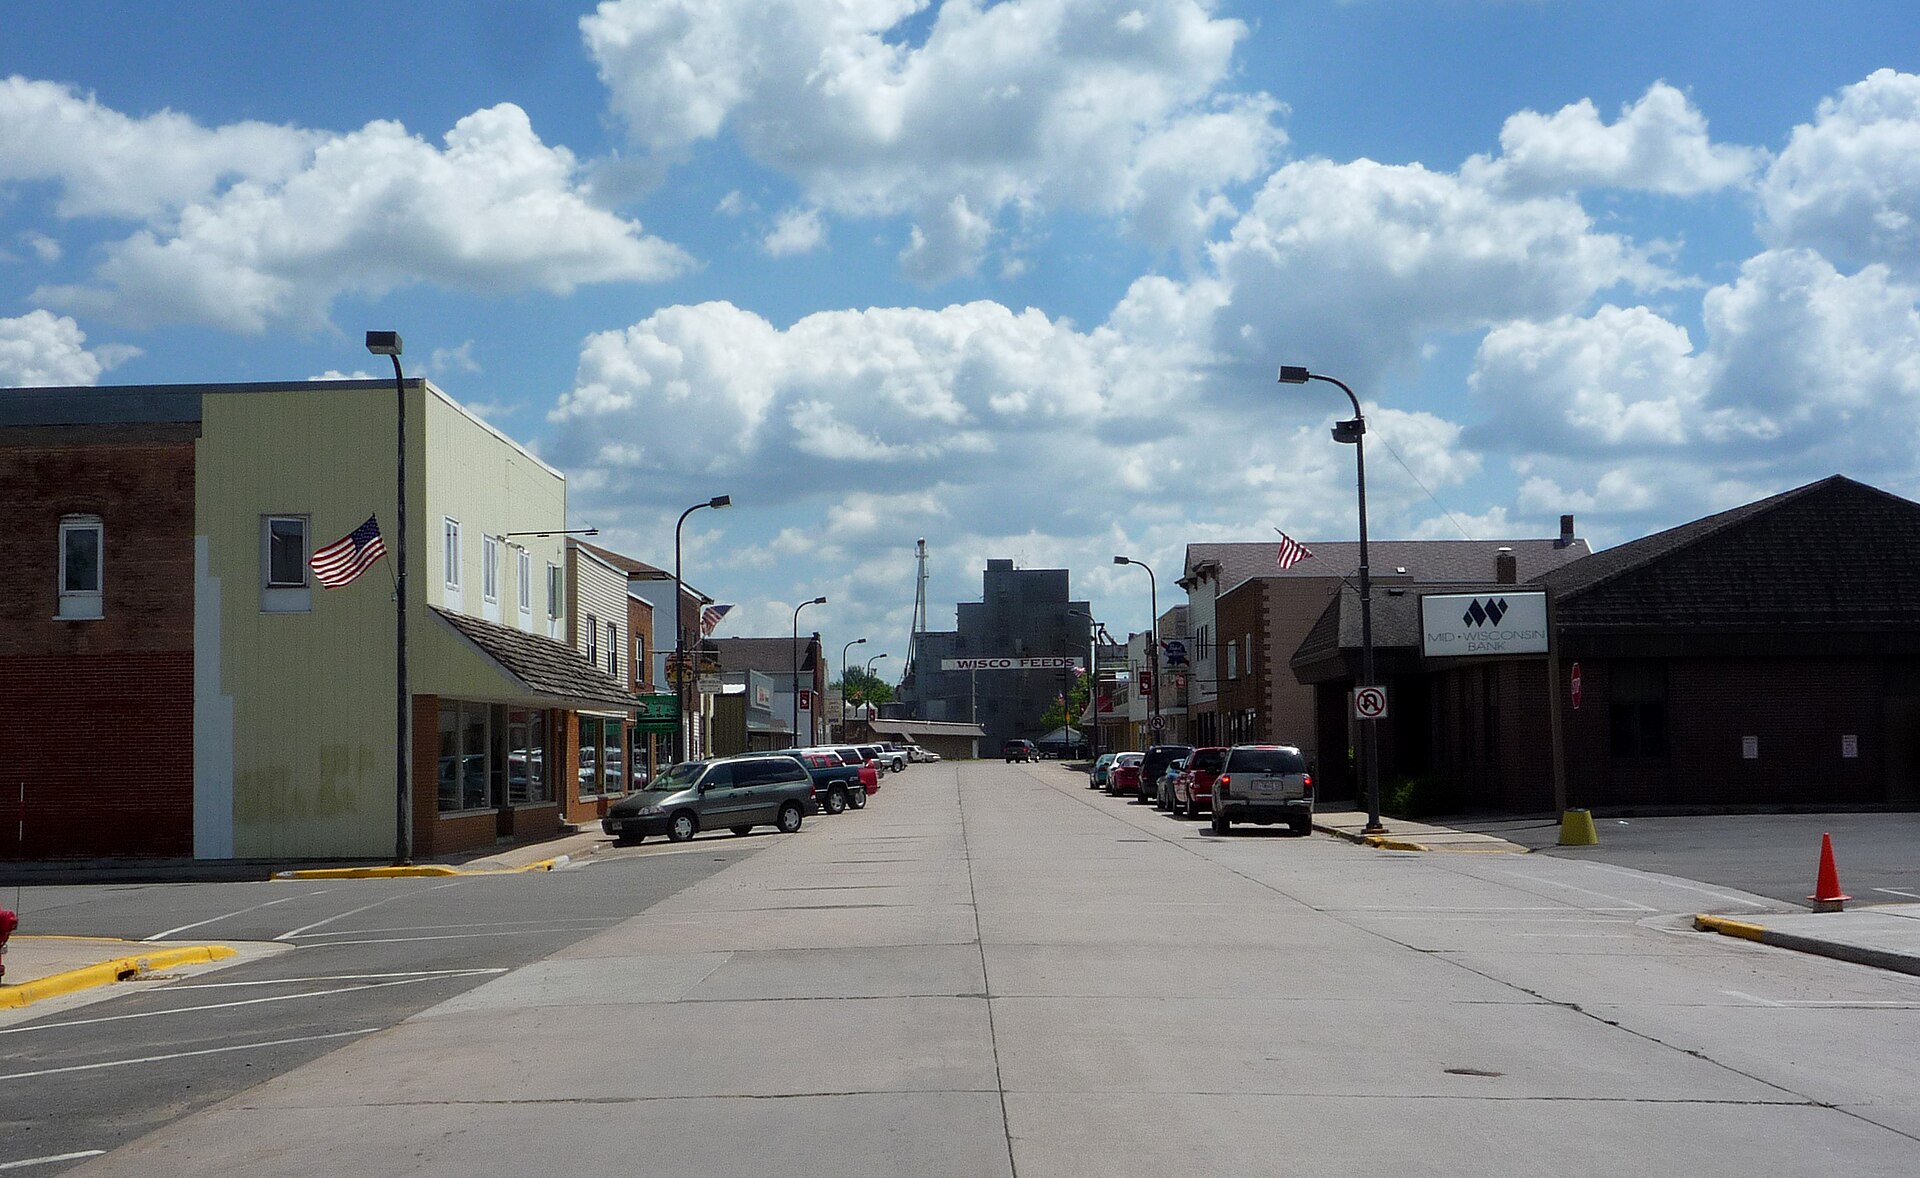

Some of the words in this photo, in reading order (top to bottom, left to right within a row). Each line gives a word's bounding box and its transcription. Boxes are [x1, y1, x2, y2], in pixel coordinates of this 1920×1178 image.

[1428, 632, 1455, 642] MID
[1463, 630, 1545, 640] WISCONSIN
[1468, 641, 1505, 652] BANK
[957, 659, 1011, 669] WISCO
[1020, 658, 1075, 667] FEEDS
